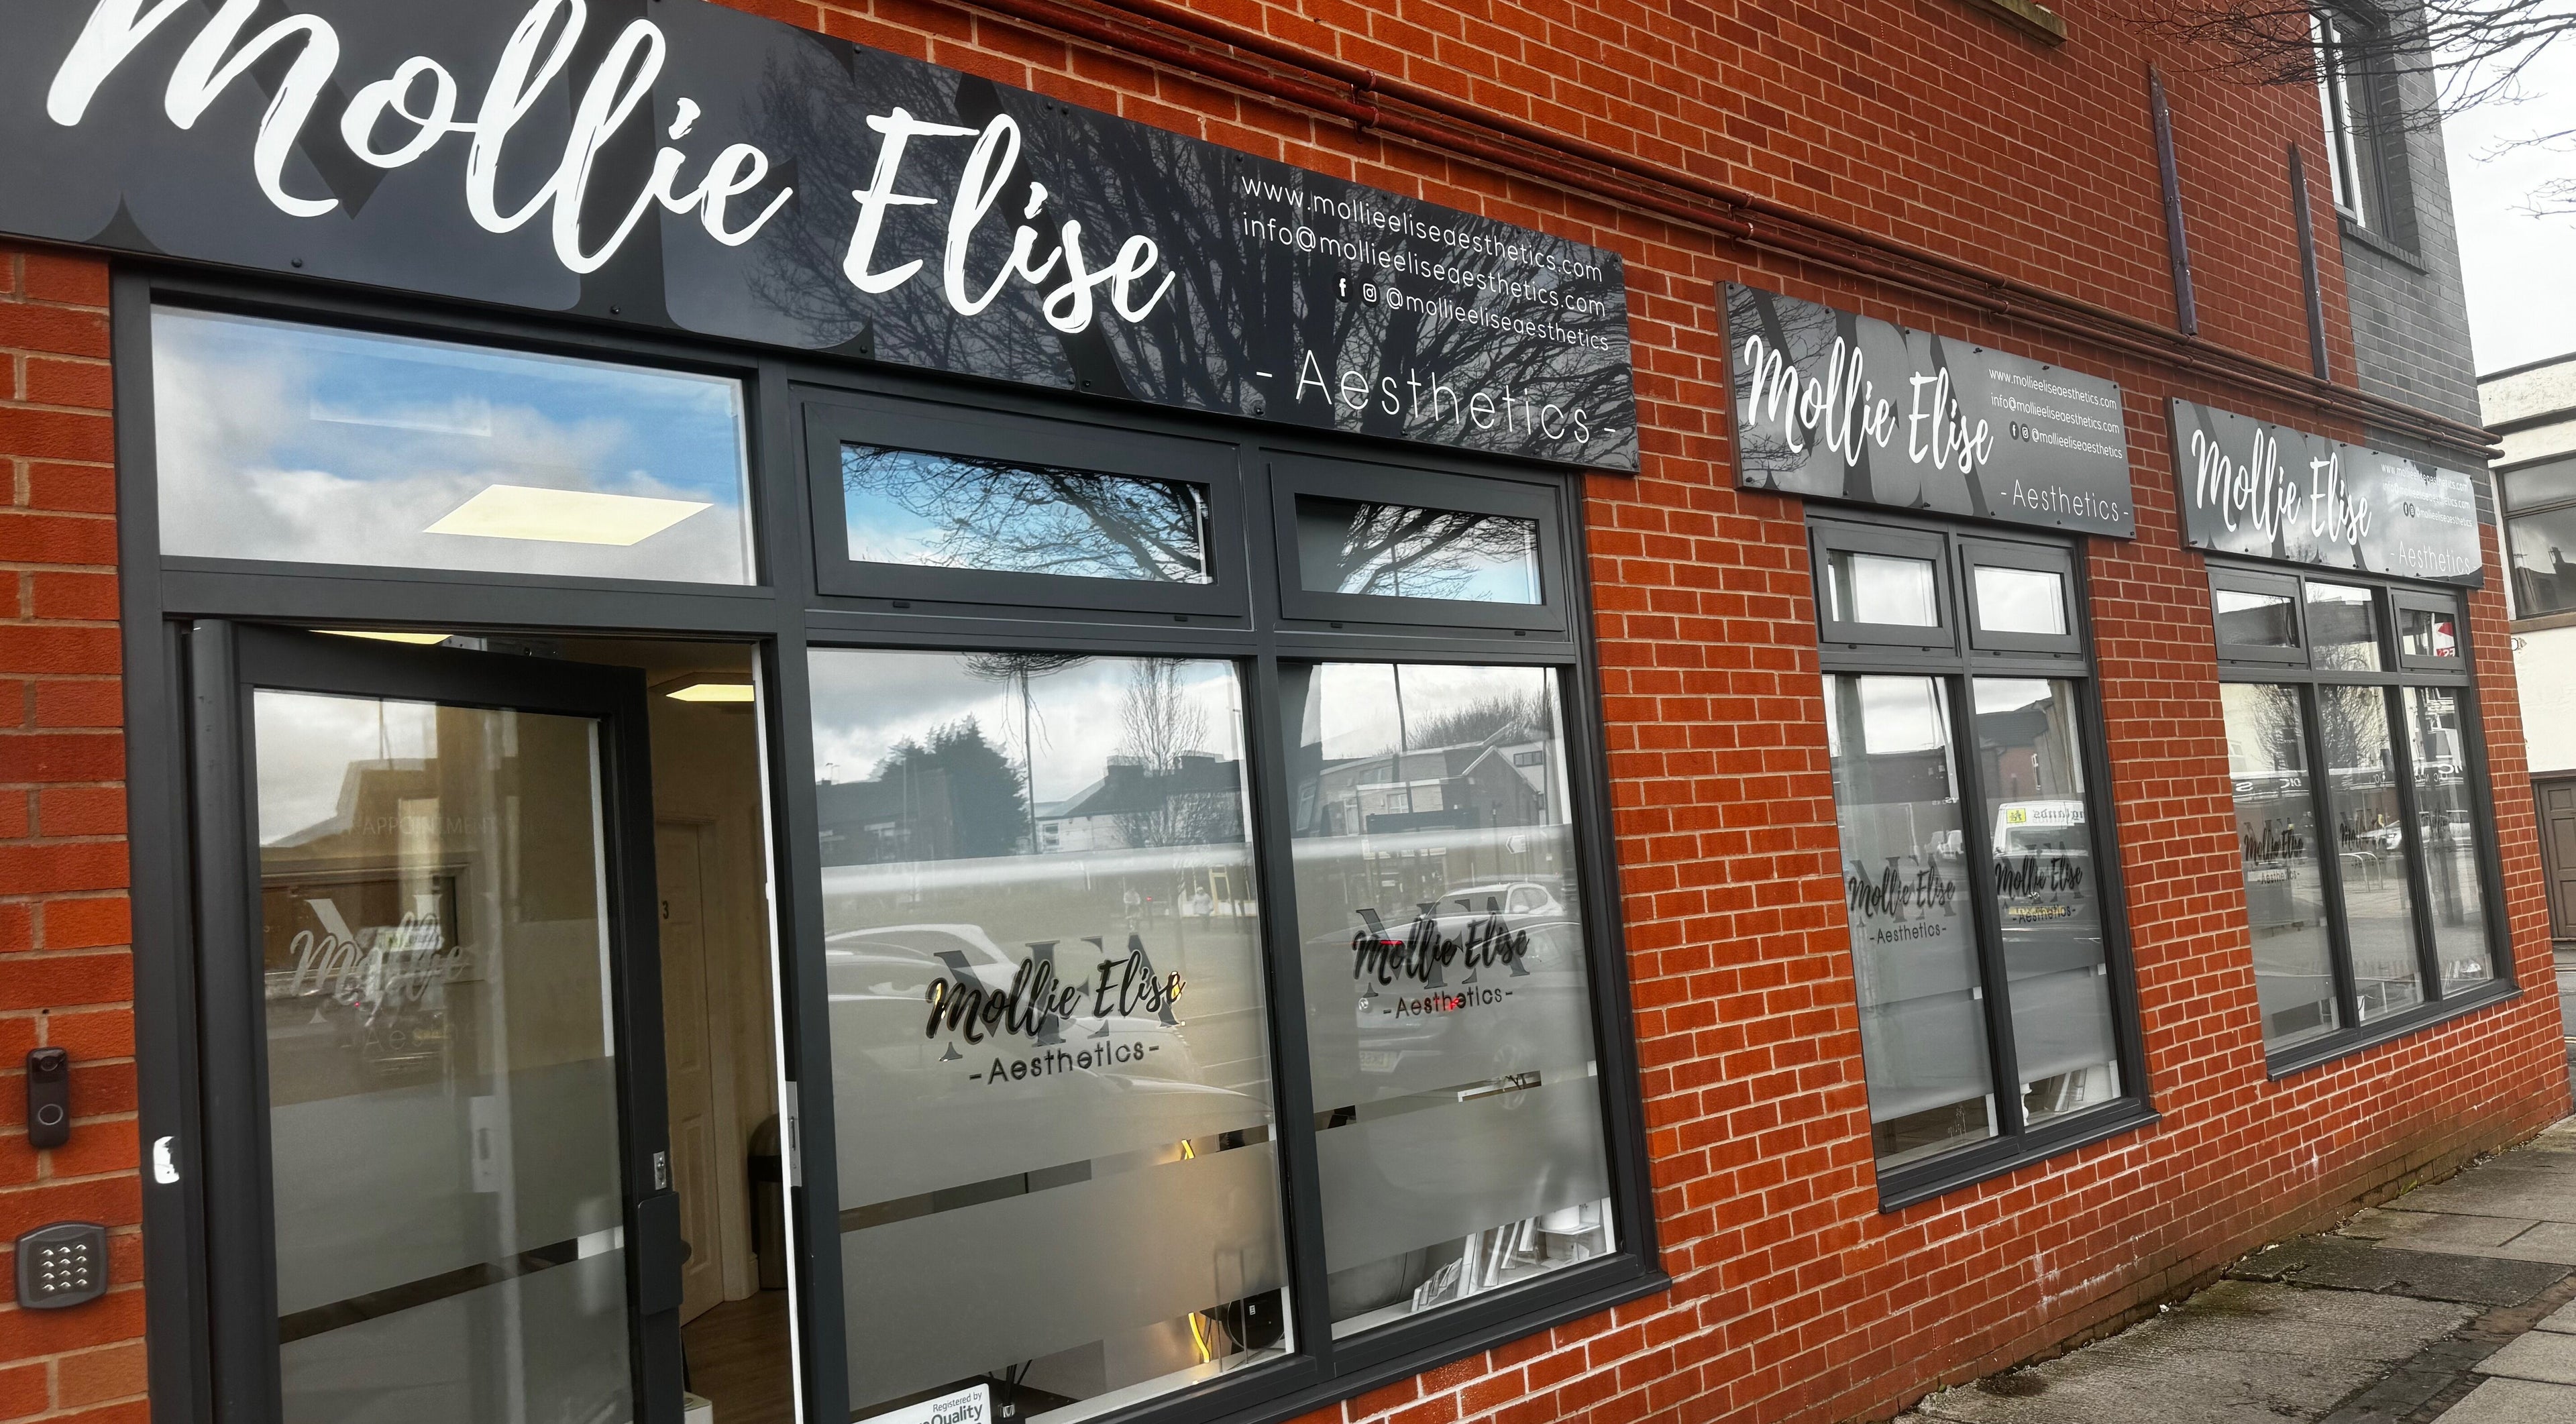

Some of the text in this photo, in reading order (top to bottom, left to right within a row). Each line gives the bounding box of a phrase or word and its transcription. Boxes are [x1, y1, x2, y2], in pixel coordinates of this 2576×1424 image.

[46, 0, 1175, 333] Mollie Elise
[1241, 174, 1602, 282] www.mollieeliseaesthetics.com
[1244, 216, 1606, 317] info@mollieeliseaesthetics.com
[1385, 289, 1609, 351] @mollieeliseaesthetics
[1744, 334, 1993, 474] Mollie Elise
[1988, 368, 2117, 410] www.mollieeliseaesthetics.com
[1991, 393, 2120, 434] info@mollieeliseaesthetics.com
[2032, 429, 2123, 459] @mollieeliseaesthetics
[2192, 428, 2371, 545] Mollie Elise
[1848, 865, 1955, 918] Mollie Elise
[1995, 854, 2083, 900] Mollie Elise
[1352, 911, 1529, 985] Mollie Elise
[925, 950, 1186, 1045] Mollie Elise
[932, 1391, 982, 1413] Registered by
